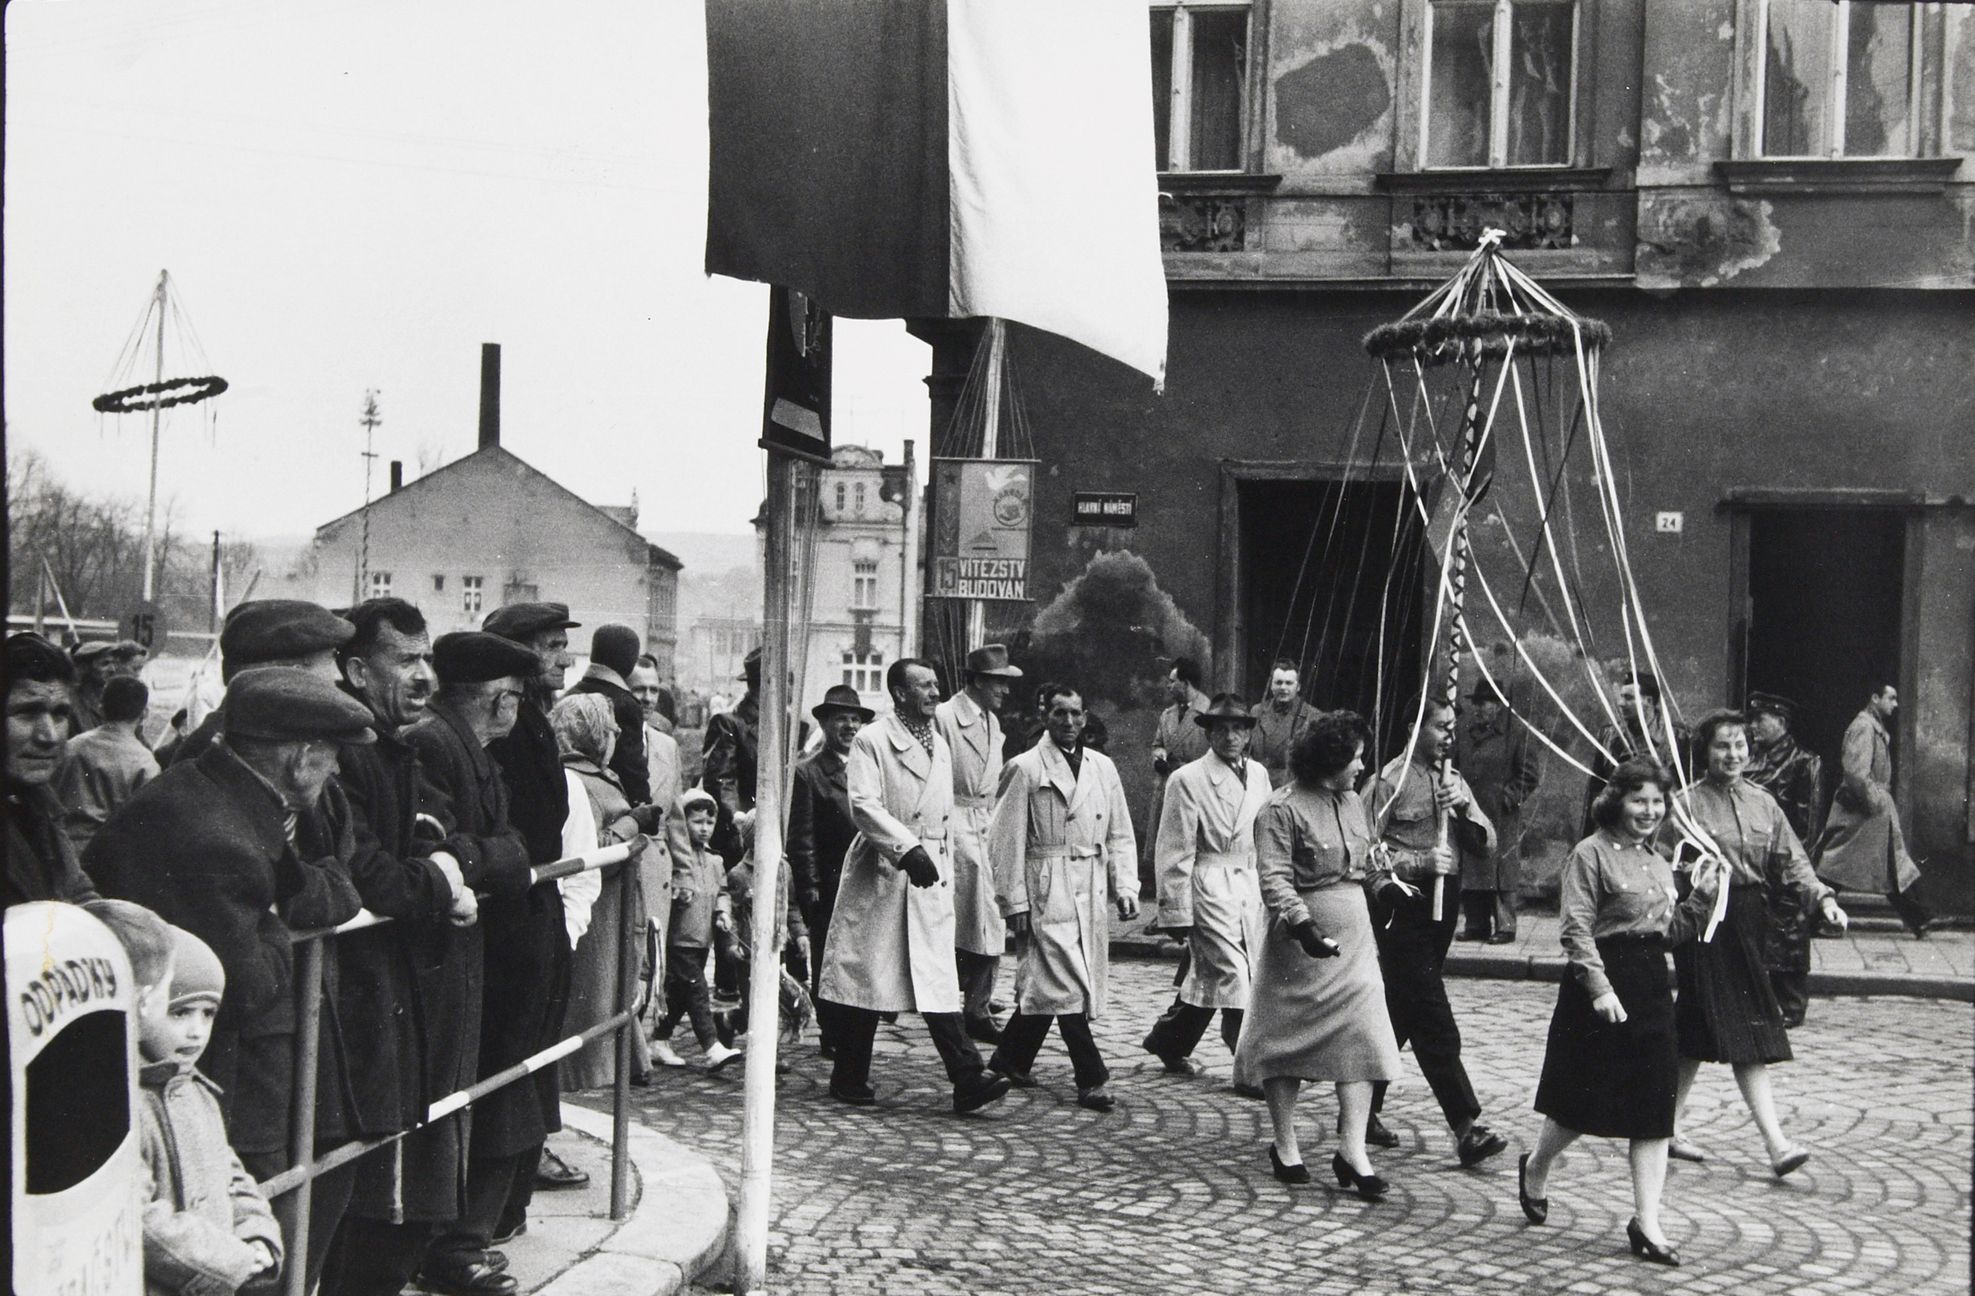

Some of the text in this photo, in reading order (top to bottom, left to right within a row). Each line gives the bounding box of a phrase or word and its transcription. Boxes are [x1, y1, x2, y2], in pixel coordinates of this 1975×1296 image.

[1662, 516, 1676, 529] 24
[132, 613, 154, 648] 15
[21, 957, 118, 1037] ODPADKY
